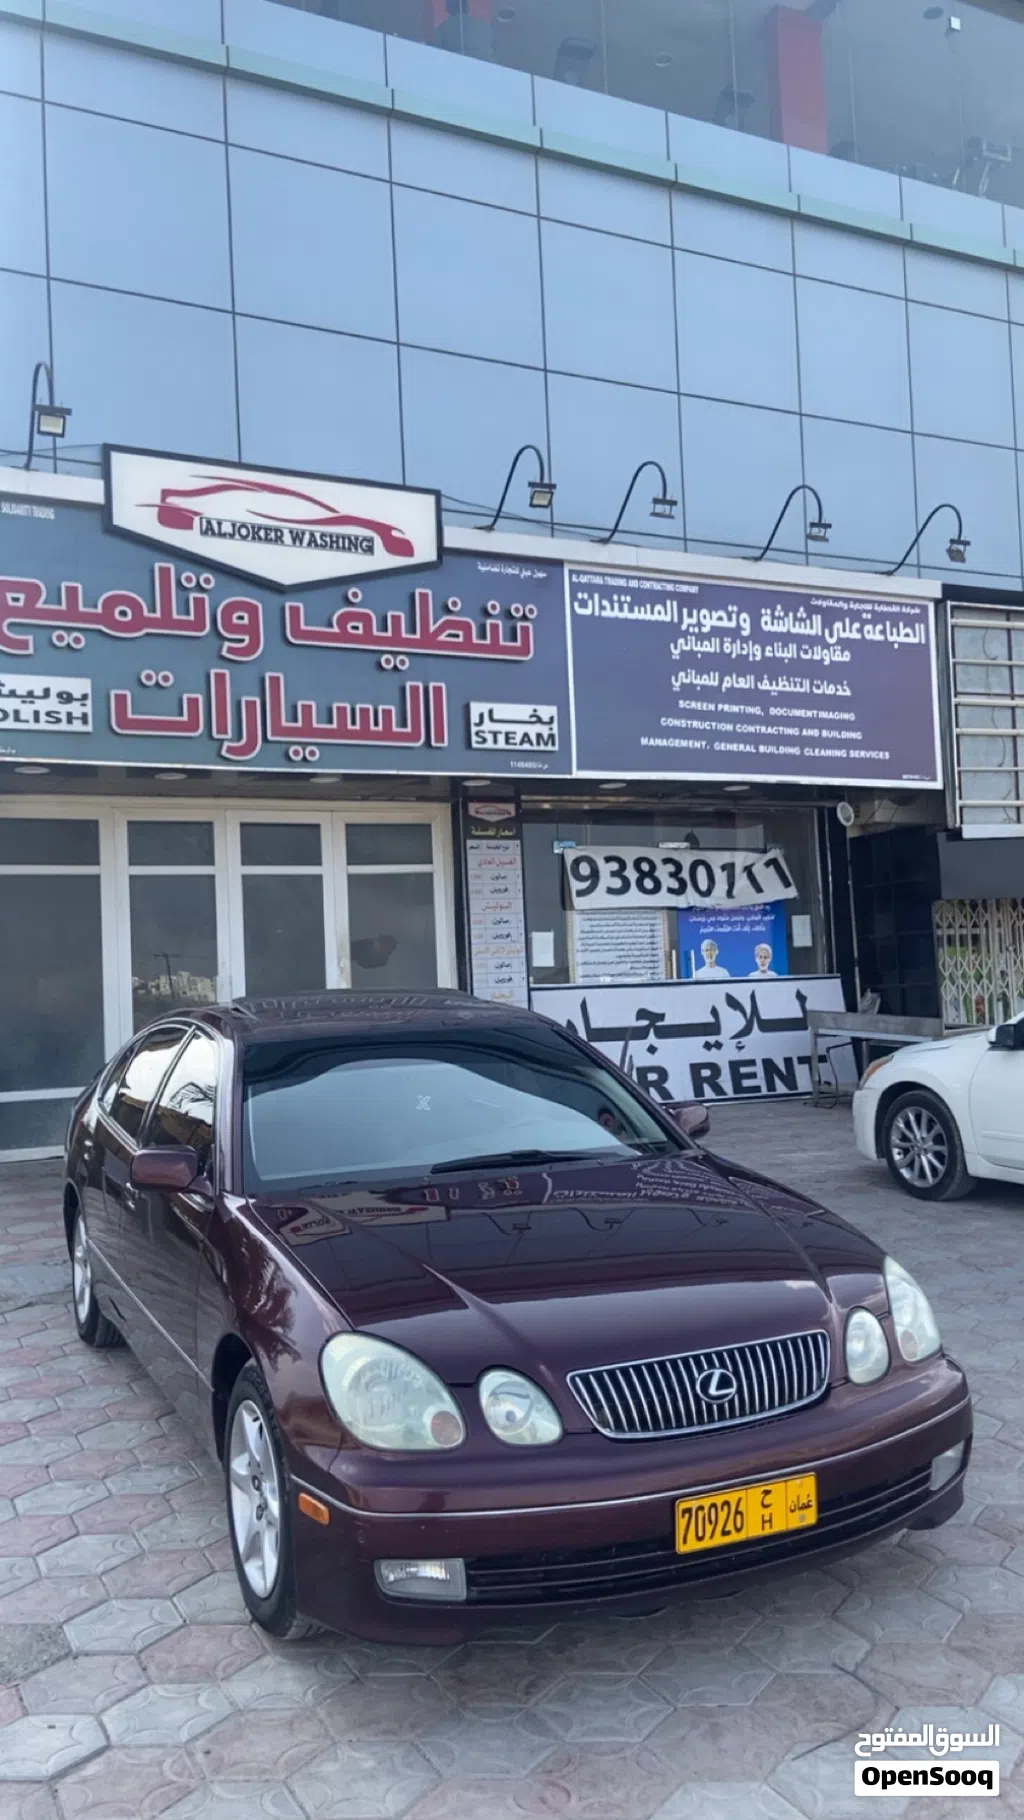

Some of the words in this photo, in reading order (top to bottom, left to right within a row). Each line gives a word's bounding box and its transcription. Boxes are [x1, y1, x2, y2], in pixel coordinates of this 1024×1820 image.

[203, 519, 285, 544] ALJOKER
[289, 529, 374, 554] WASHING
[628, 578, 639, 588] AND
[640, 580, 675, 592] CONTRACTING
[675, 584, 699, 594] COMPANY
[0, 562, 264, 661] وتلميع
[573, 591, 678, 623] المستندات
[810, 598, 848, 611] والمقاولات
[849, 601, 873, 611] للتجارة
[901, 604, 920, 614] شركة
[285, 586, 538, 670] تنظيف
[681, 604, 751, 636] وتصوير
[760, 604, 822, 636] الشاشة
[824, 617, 862, 644] على
[863, 612, 926, 649] الطباعة
[670, 635, 720, 660] المباني
[723, 637, 762, 661] وإدارة
[764, 641, 797, 663] البناء
[800, 643, 851, 665] مقاولات
[671, 668, 719, 691] للمباني
[722, 673, 755, 692] العام
[757, 675, 810, 696] التنظيف
[812, 680, 852, 696] خدمات
[110, 669, 448, 761] السيارات
[473, 708, 554, 731] بخار
[678, 700, 716, 712] SCREEN
[717, 703, 765, 717] PRINTING,
[474, 730, 556, 747] STEAM
[660, 718, 733, 731] CONSTRUCTION
[735, 723, 800, 736] CONTRACTING
[801, 728, 819, 738] AND
[821, 729, 862, 740] BUILDING
[714, 741, 757, 753] GENERAL
[758, 744, 801, 755] BUILDING
[804, 747, 847, 758] CLEANING
[849, 749, 890, 760] SERVICES
[569, 854, 792, 899] 93830111
[689, 1053, 828, 1098] RENT
[761, 1489, 772, 1508] ح
[682, 1497, 744, 1545] 70926
[761, 1513, 773, 1531] H
